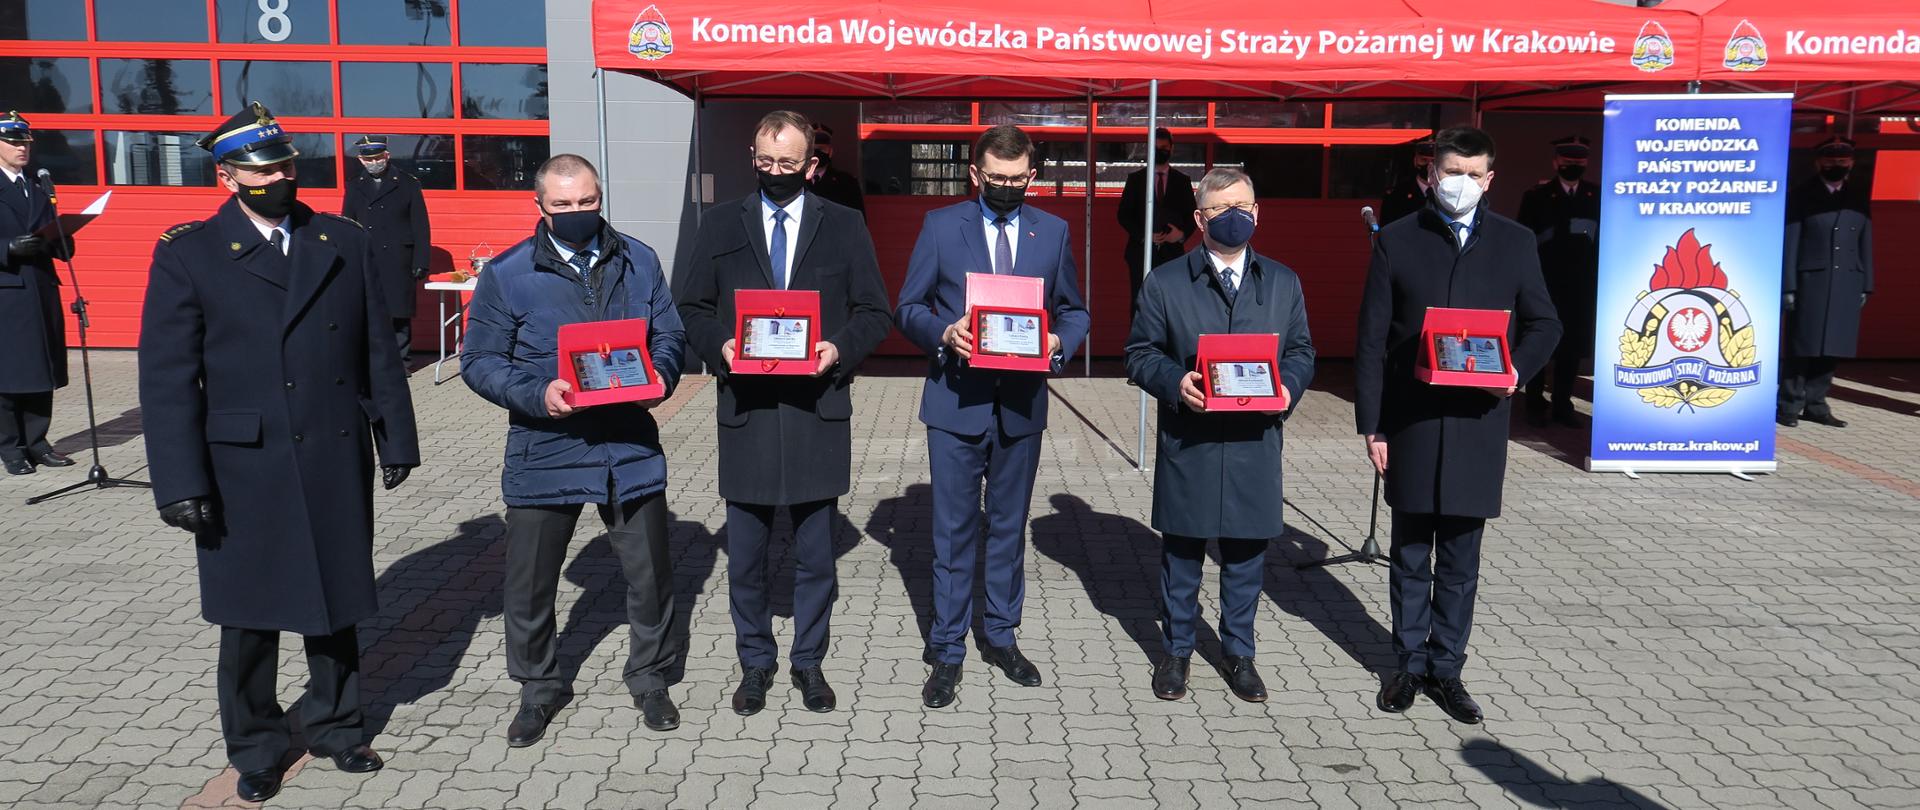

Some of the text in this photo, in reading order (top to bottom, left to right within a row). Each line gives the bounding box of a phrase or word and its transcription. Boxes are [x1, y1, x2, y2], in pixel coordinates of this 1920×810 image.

[258, 0, 292, 42] 8
[692, 17, 1616, 60] Komenda Wojewódzka Państwowej Straży Pożarnej w Krakowie
[1785, 29, 1920, 55] Komenda
[1655, 118, 1741, 132] KOMENDA
[1636, 136, 1759, 152] WOJEWÓDZKA
[1637, 158, 1756, 174] PAŃSTWOWEJ
[1614, 179, 1778, 194] STRAŻY POŻARNEJ
[1639, 201, 1751, 215] W KRAKOWIE
[1617, 361, 1756, 385] PAŃSTWOWA STRAŻ POŻARNA
[1608, 440, 1760, 454] www.straz.krakow.pl
